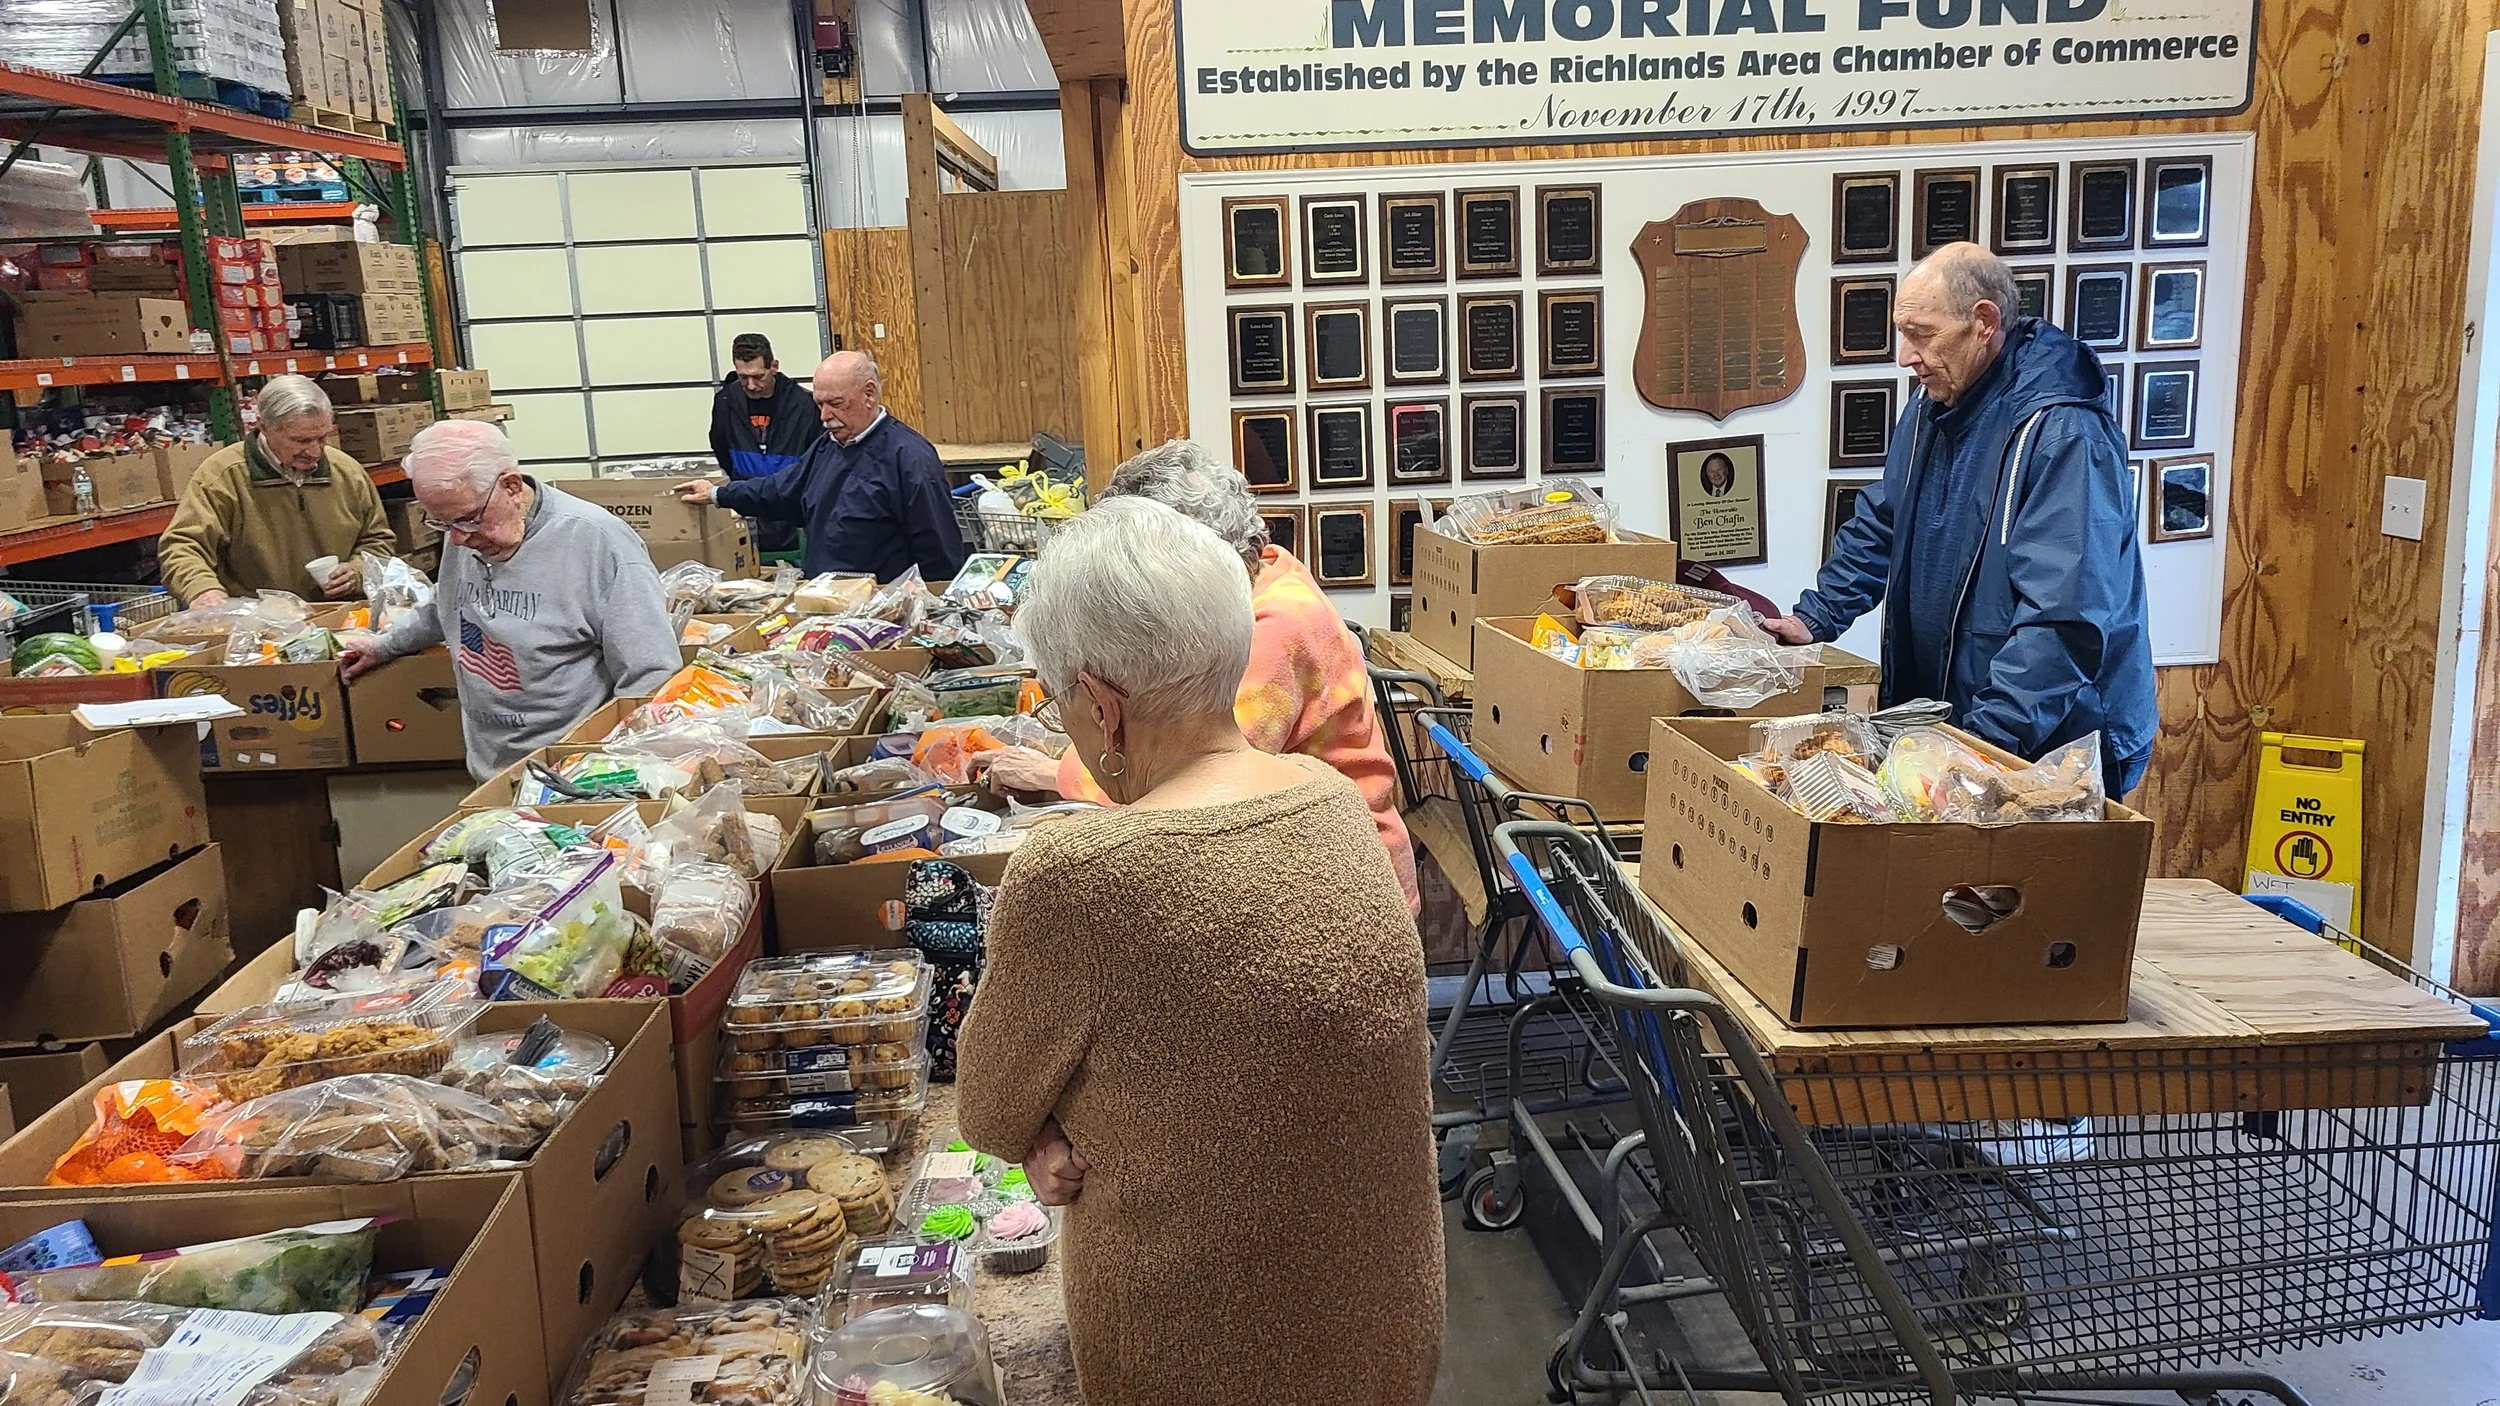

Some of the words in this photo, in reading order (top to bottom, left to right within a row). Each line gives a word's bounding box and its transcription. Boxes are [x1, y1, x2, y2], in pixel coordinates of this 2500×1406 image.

[1332, 0, 1826, 48] MEMORIAL
[1197, 61, 1410, 94] Established
[1422, 58, 1466, 92] by
[1477, 57, 1538, 86] the
[1550, 51, 1724, 84] Richlands
[1737, 49, 1820, 78] Area
[1832, 41, 1992, 74] Chamber
[2004, 38, 2041, 67] of
[2052, 34, 2239, 64] Commerce
[1519, 90, 1714, 130] November
[1726, 86, 1818, 125] 17th,
[1834, 87, 1922, 118] 1997
[1693, 517, 1713, 529] Ben
[1716, 514, 1745, 527] Chafin
[249, 686, 322, 721] Fyffes
[1713, 774, 1729, 793] PACKER
[2296, 797, 2321, 811] NO
[2280, 809, 2336, 827] ENTRY
[2253, 875, 2295, 892] WET
